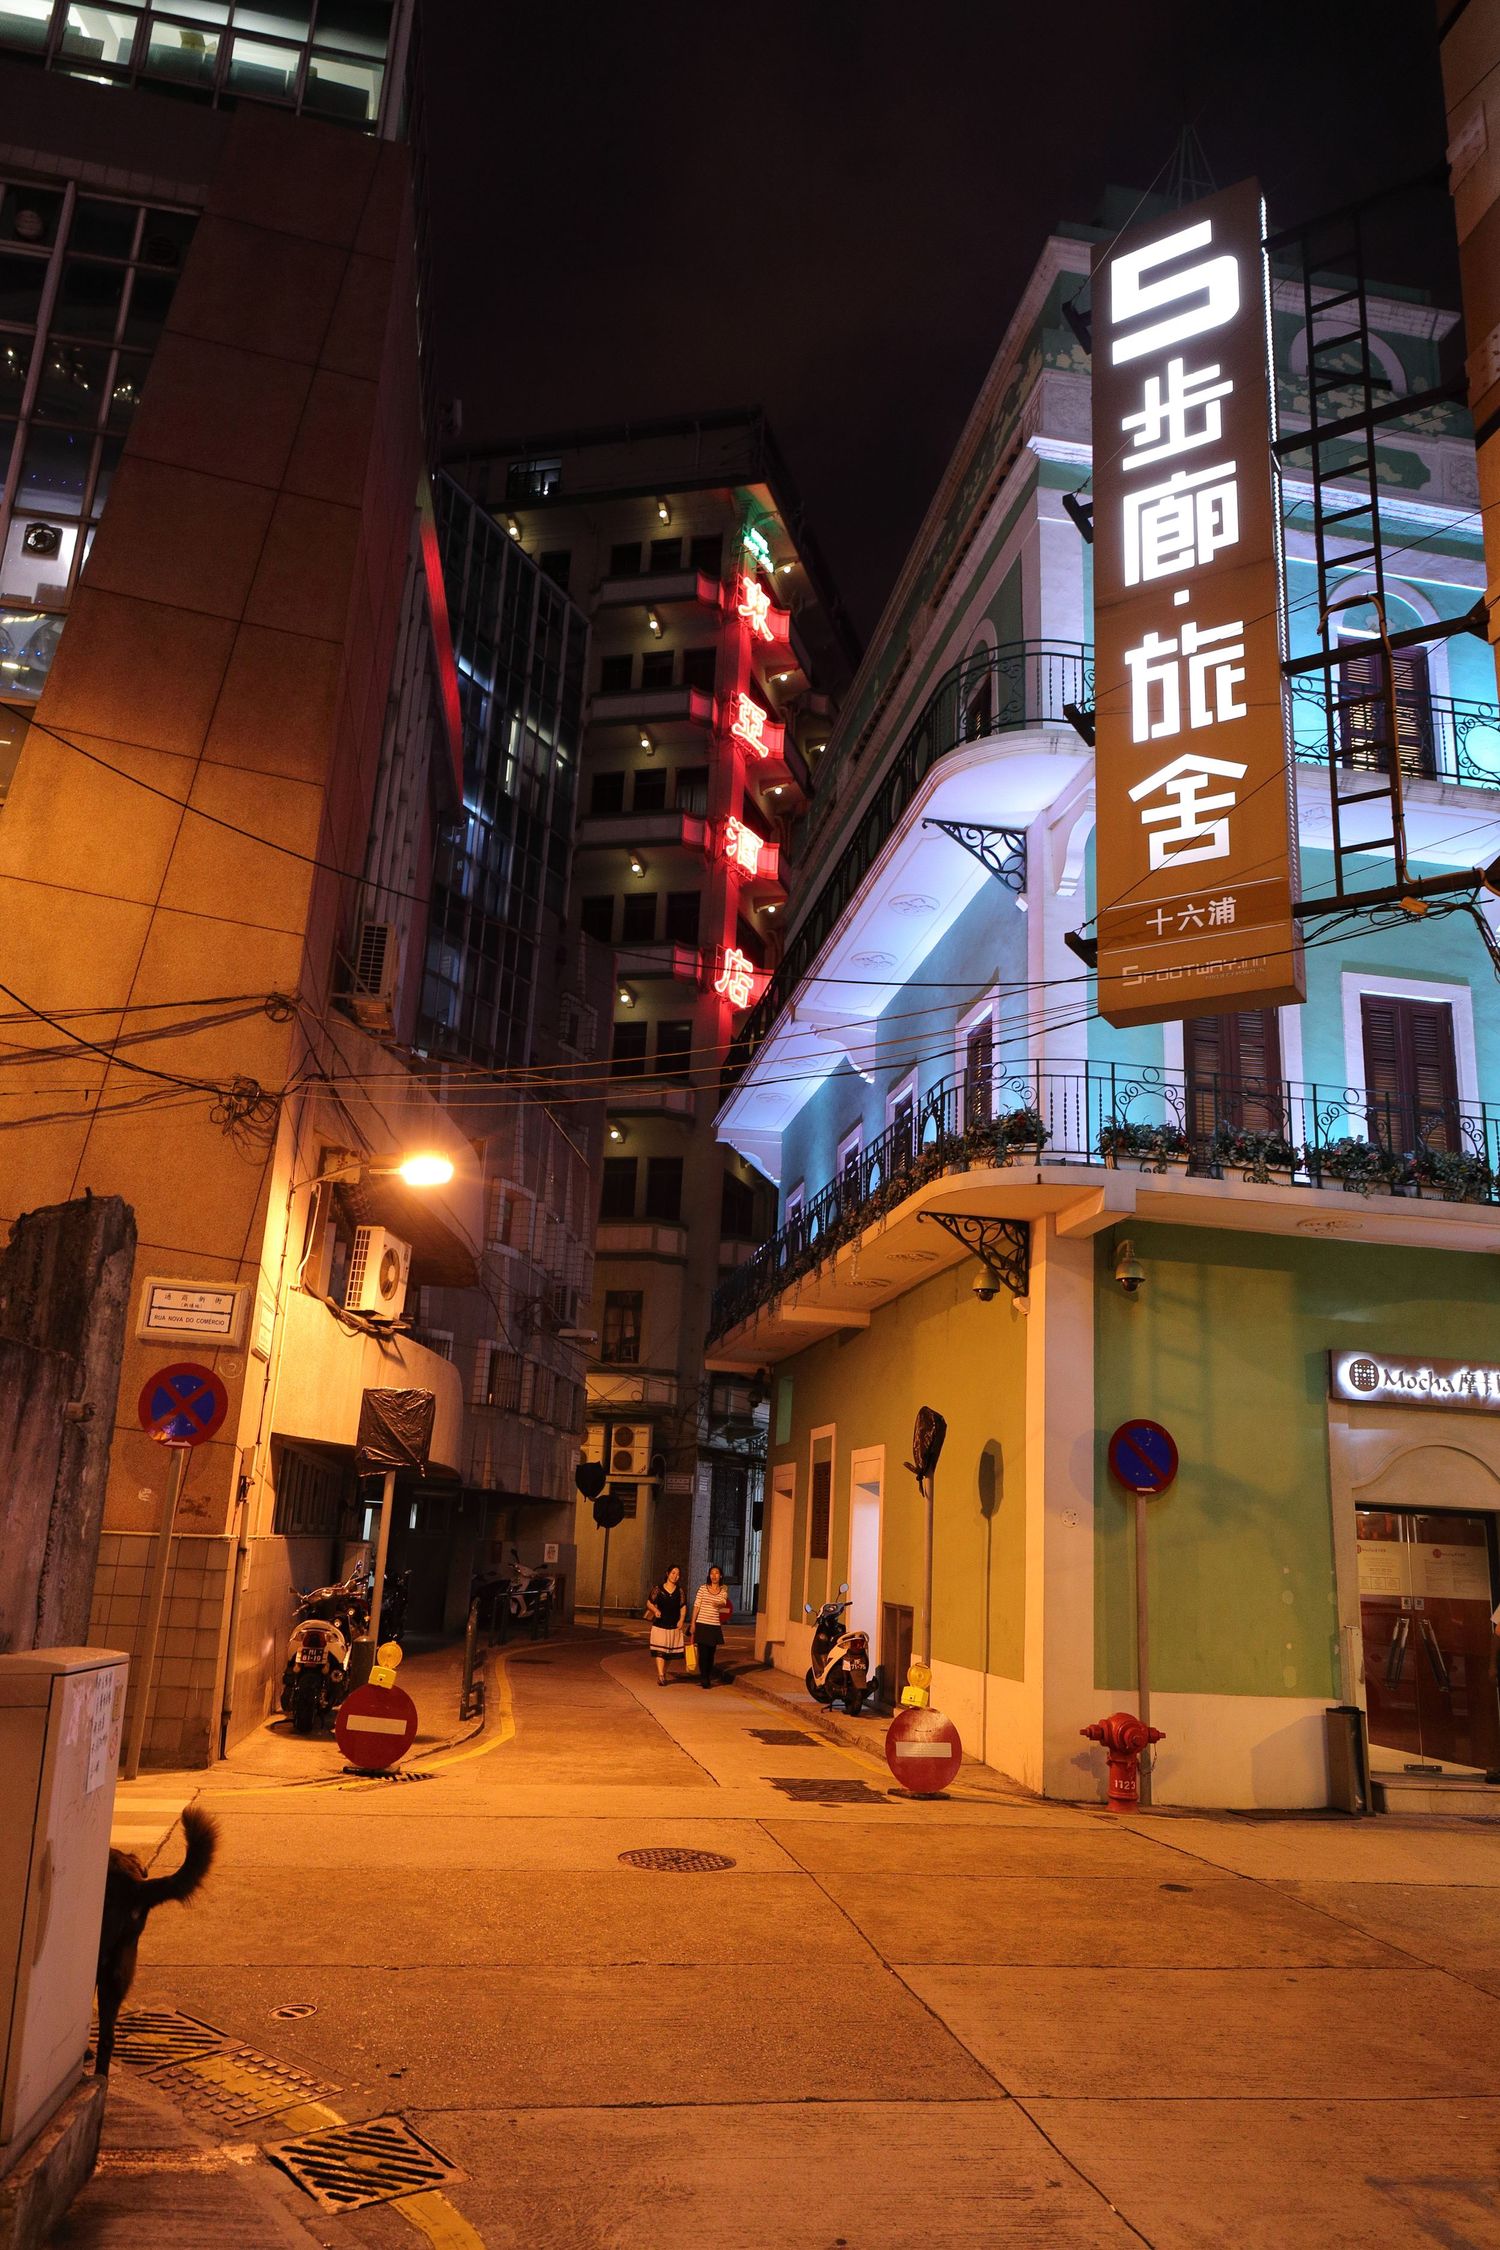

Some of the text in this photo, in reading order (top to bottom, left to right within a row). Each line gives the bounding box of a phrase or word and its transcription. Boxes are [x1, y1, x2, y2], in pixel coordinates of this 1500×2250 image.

[1146, 896, 1237, 936] 十六浦
[1383, 1368, 1455, 1394] Mocha
